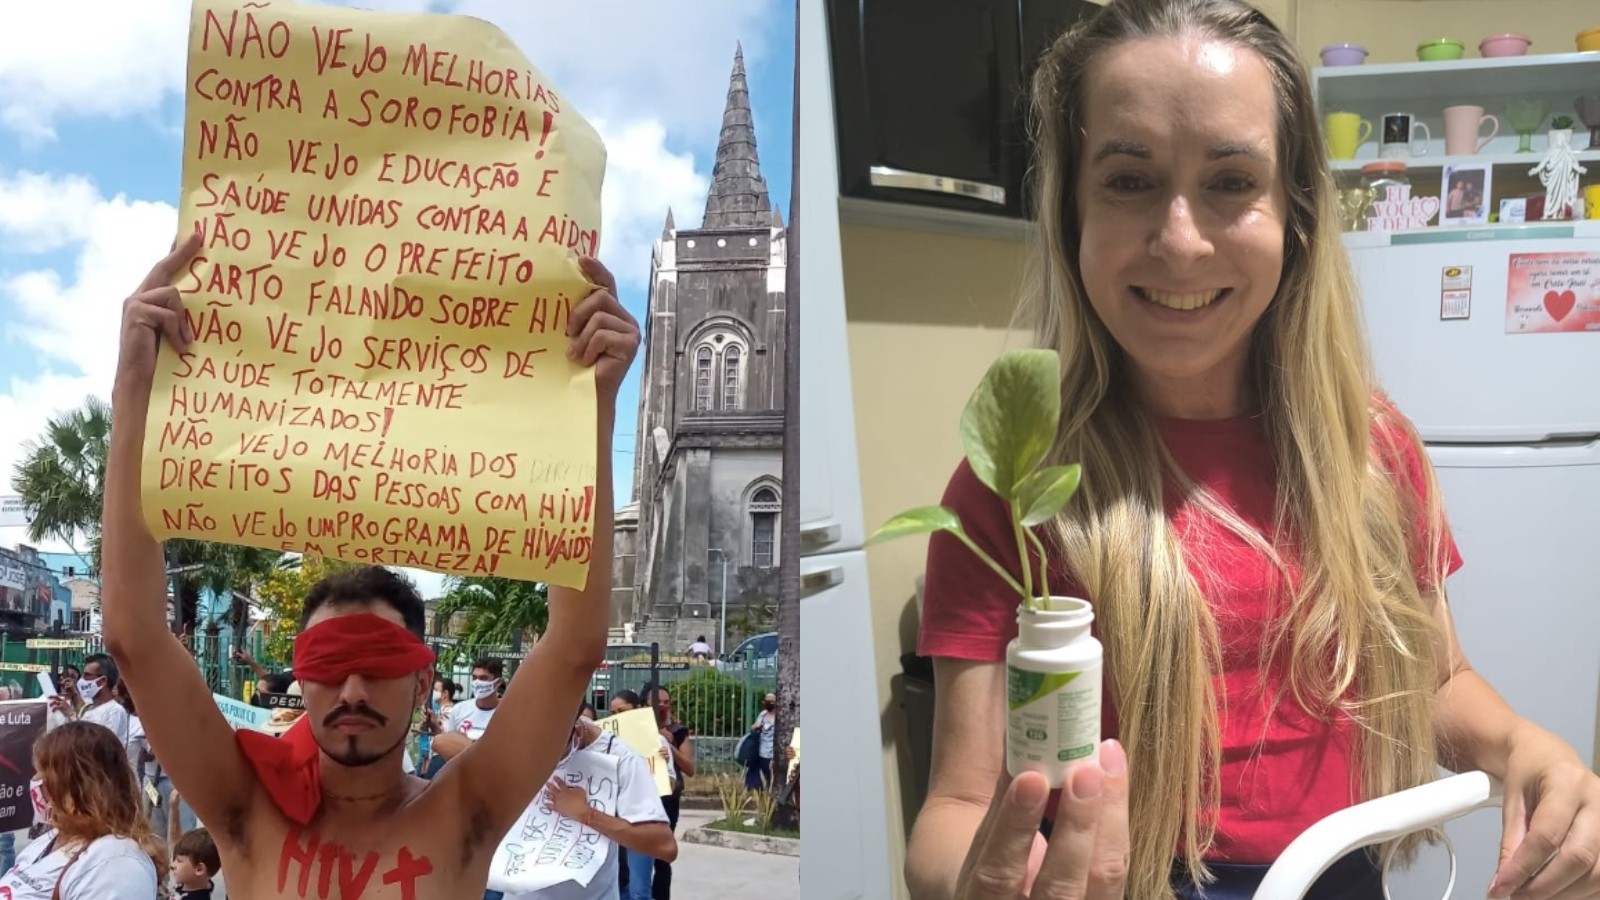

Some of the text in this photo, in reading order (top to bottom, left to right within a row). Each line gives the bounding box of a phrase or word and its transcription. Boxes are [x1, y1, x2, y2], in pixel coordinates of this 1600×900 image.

[202, 2, 560, 113] NÃO VEJO MELHORIAS
[195, 68, 553, 160] CONTRA A SOROFOBIA!
[199, 114, 559, 198] NÃO VEJO EDUCAÇÃO E
[196, 173, 290, 214] SAÚDE
[308, 194, 402, 228] UNIDAS
[417, 204, 506, 235] CONTRA
[512, 216, 528, 242] A
[194, 212, 533, 286] NÃO VEJO O PREFEITO
[180, 257, 283, 306] SARTO
[308, 280, 424, 320] FALANDO
[430, 294, 519, 330] SOBRE
[185, 301, 547, 381] NÃO VEJO SERVIÇOS DE
[173, 350, 468, 410] SAÚDE TOTALMENTE
[170, 384, 394, 444] HUMANIZADOS!
[160, 417, 213, 452] NÃO
[241, 433, 308, 460] VEJO
[324, 442, 458, 476] MELHORIA
[470, 451, 518, 479] DOS
[160, 456, 293, 494] DIREITOS
[313, 470, 361, 504] DAS
[375, 473, 462, 514] PESSOAS
[475, 491, 527, 521] COM
[163, 503, 216, 531] NÃO
[233, 508, 297, 538] VEJO
[484, 526, 516, 554] DE
[281, 541, 500, 576] EM FORTALEZA!
[8, 711, 31, 725] Luta
